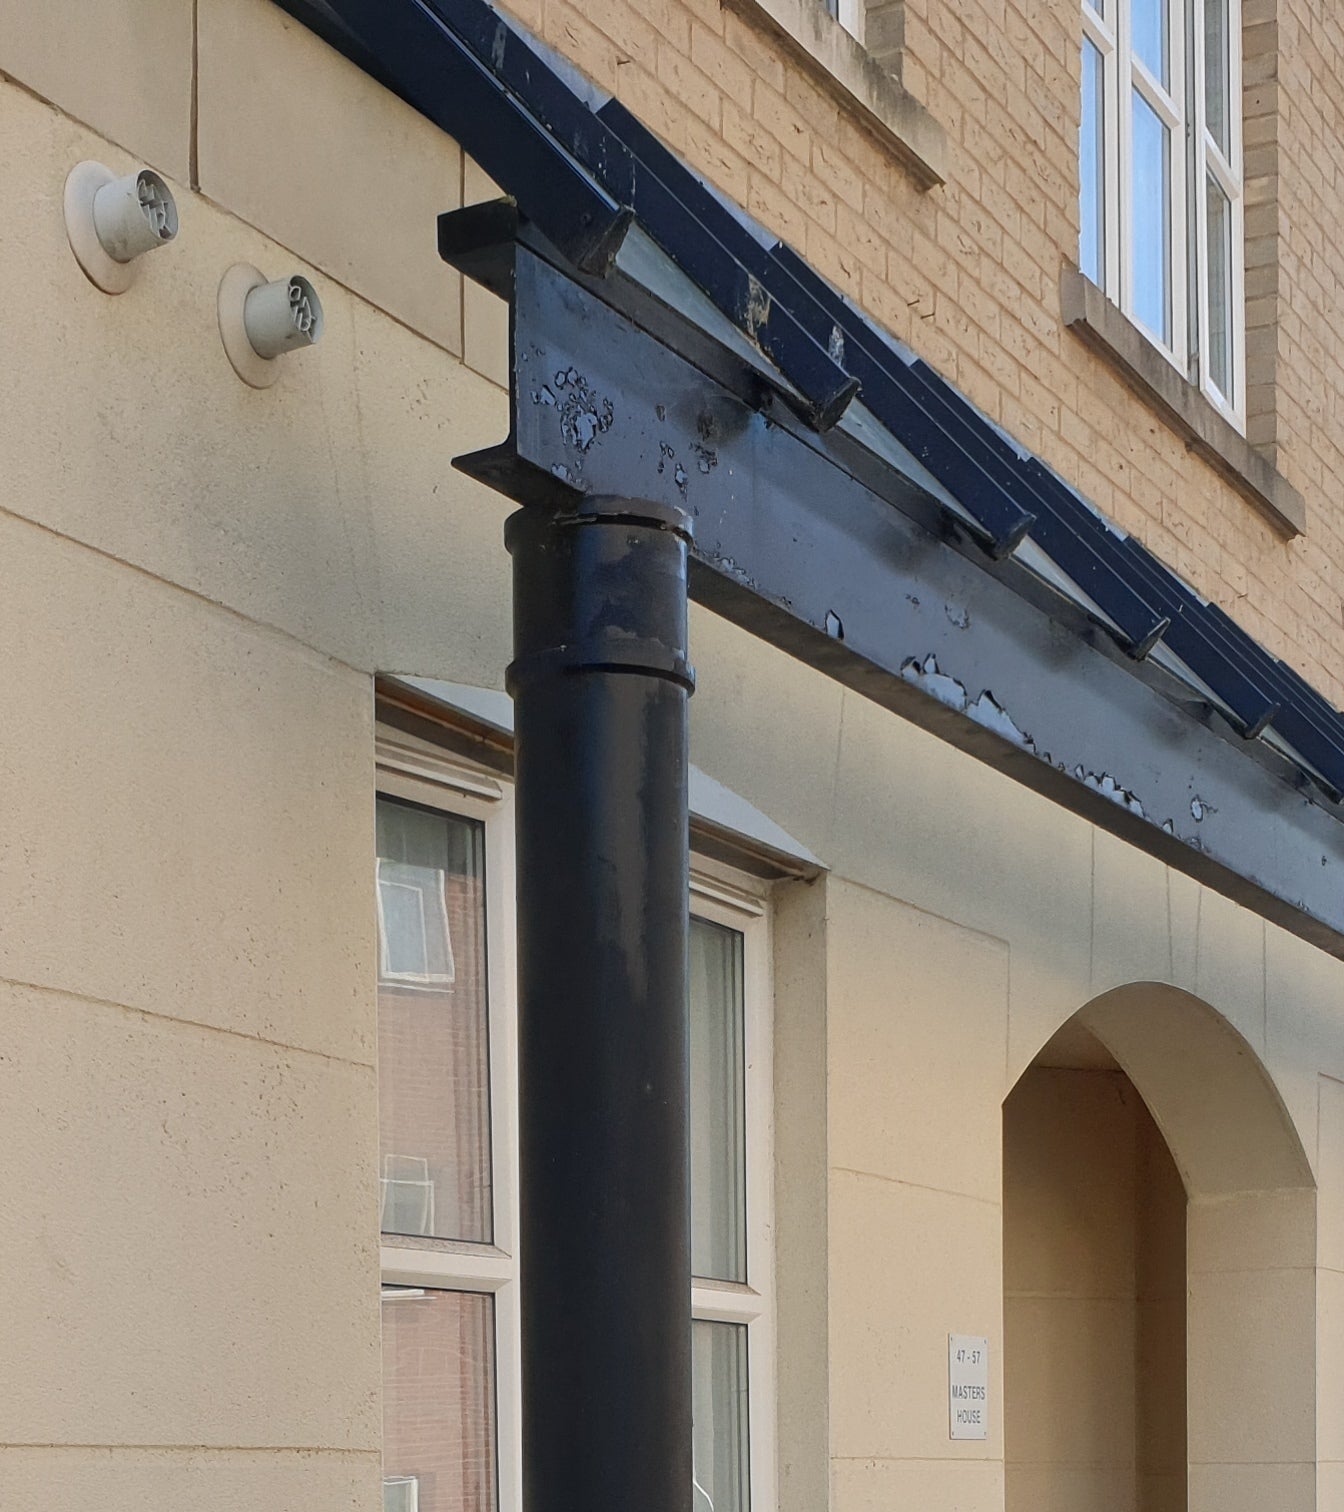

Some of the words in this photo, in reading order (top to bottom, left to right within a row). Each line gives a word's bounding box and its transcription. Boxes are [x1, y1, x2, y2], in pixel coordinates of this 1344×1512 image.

[956, 1349, 966, 1363] 47
[972, 1350, 981, 1364] 57
[952, 1384, 986, 1400] MASTERS
[956, 1410, 981, 1424] HOUSE
